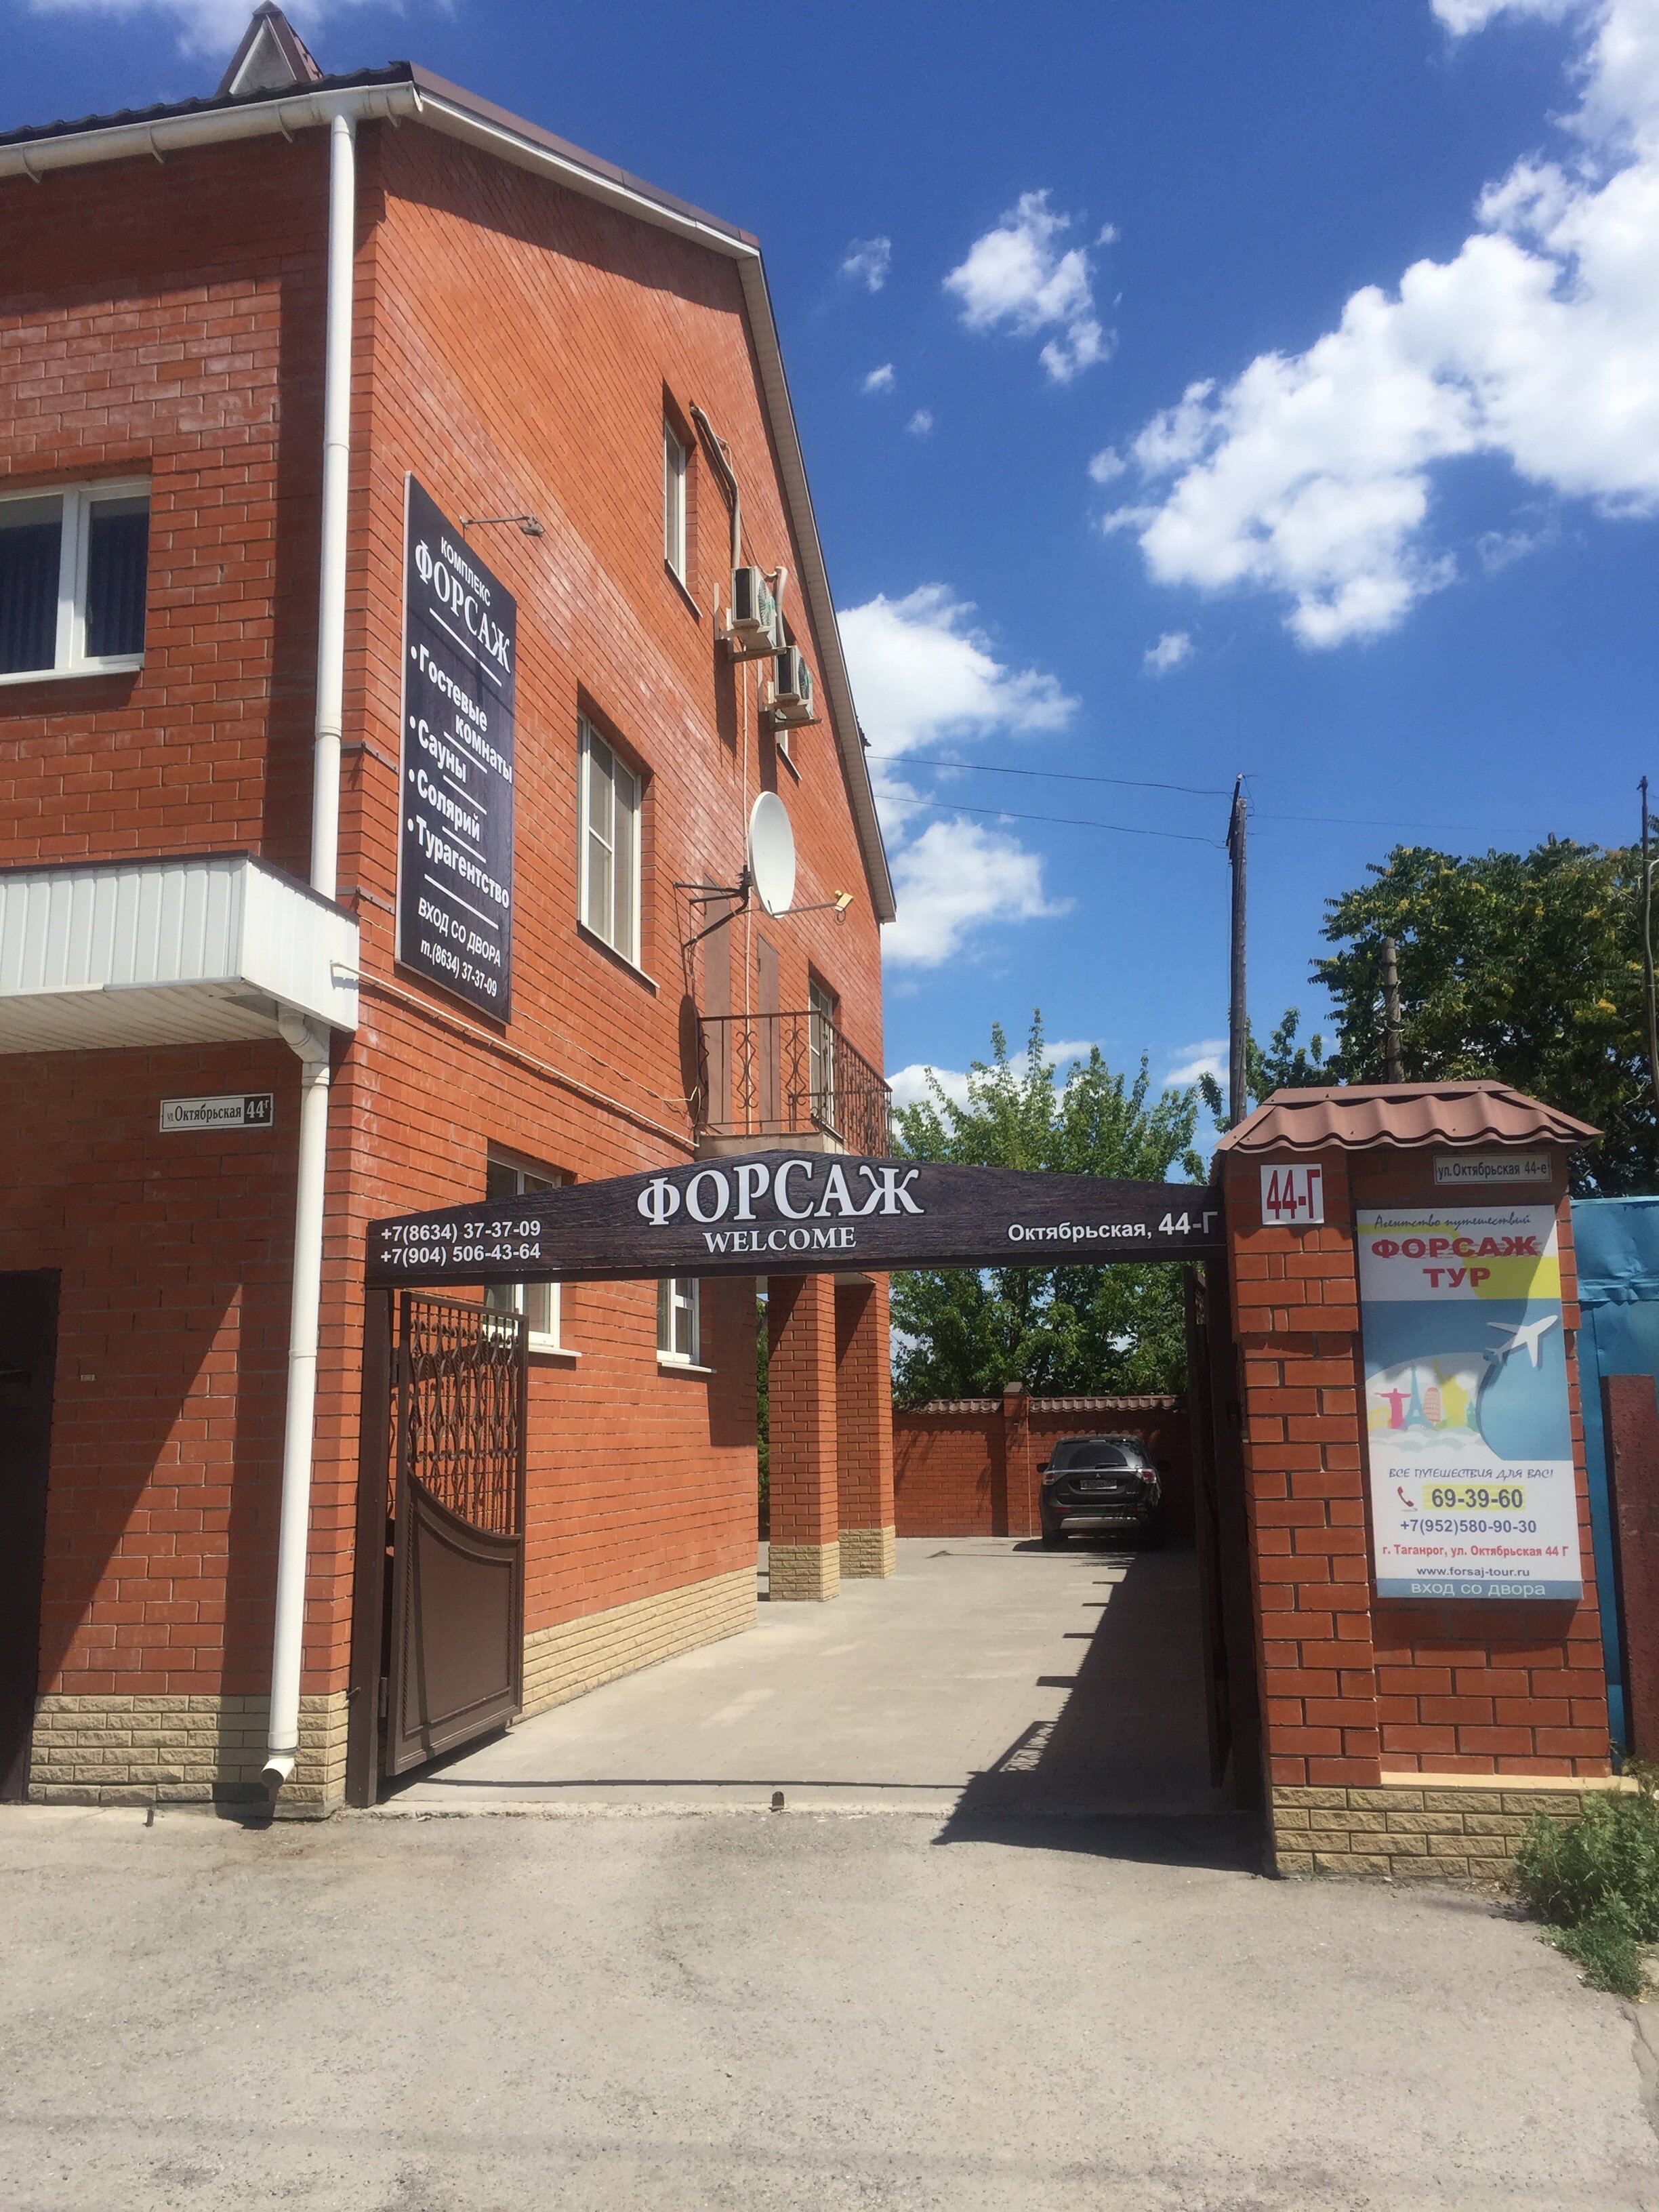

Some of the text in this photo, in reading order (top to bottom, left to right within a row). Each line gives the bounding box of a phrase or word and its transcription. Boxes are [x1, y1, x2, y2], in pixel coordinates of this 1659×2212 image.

[441, 536, 491, 607] КОМПЛЕКС
[415, 539, 510, 674] ФОРСАЖ
[419, 644, 488, 731] Гостевые
[418, 719, 466, 783] Сауны
[456, 714, 512, 783] комнаты
[417, 769, 480, 842] Солярий
[416, 815, 509, 909] Турагентство
[418, 897, 501, 967] ВХОД СО ДВОРА
[462, 962, 497, 997] 37-37-09
[175, 1103, 241, 1123] Октябрьская
[637, 1160, 924, 1225] ФОРСАЖ
[1267, 1169, 1320, 1219] 44-Г
[381, 1221, 541, 1245] +7(8634) 37-37-09
[1008, 1211, 1218, 1243] Октябрьская, 44-Г
[1374, 1212, 1530, 1231] Агентство путешествий
[702, 1227, 857, 1253] WELCOME
[1371, 1235, 1540, 1258] ФОРСАЖ
[381, 1243, 541, 1267] +7(904) 506-43-64
[1422, 1267, 1491, 1288] ТУР
[1389, 1469, 1553, 1481] ВСЕ ПУТЕШЕСТВИЯ ДЛЯ ВАС!
[1431, 1488, 1523, 1508] 69-39-60
[1400, 1519, 1537, 1536] +7(952)580-90-30
[1393, 1544, 1448, 1558] Таганрог,
[1451, 1547, 1467, 1557] ул.
[1471, 1545, 1542, 1559] Октябрьская
[1545, 1546, 1559, 1556] 44
[1417, 1567, 1530, 1578] www.forsaj-tour.ru
